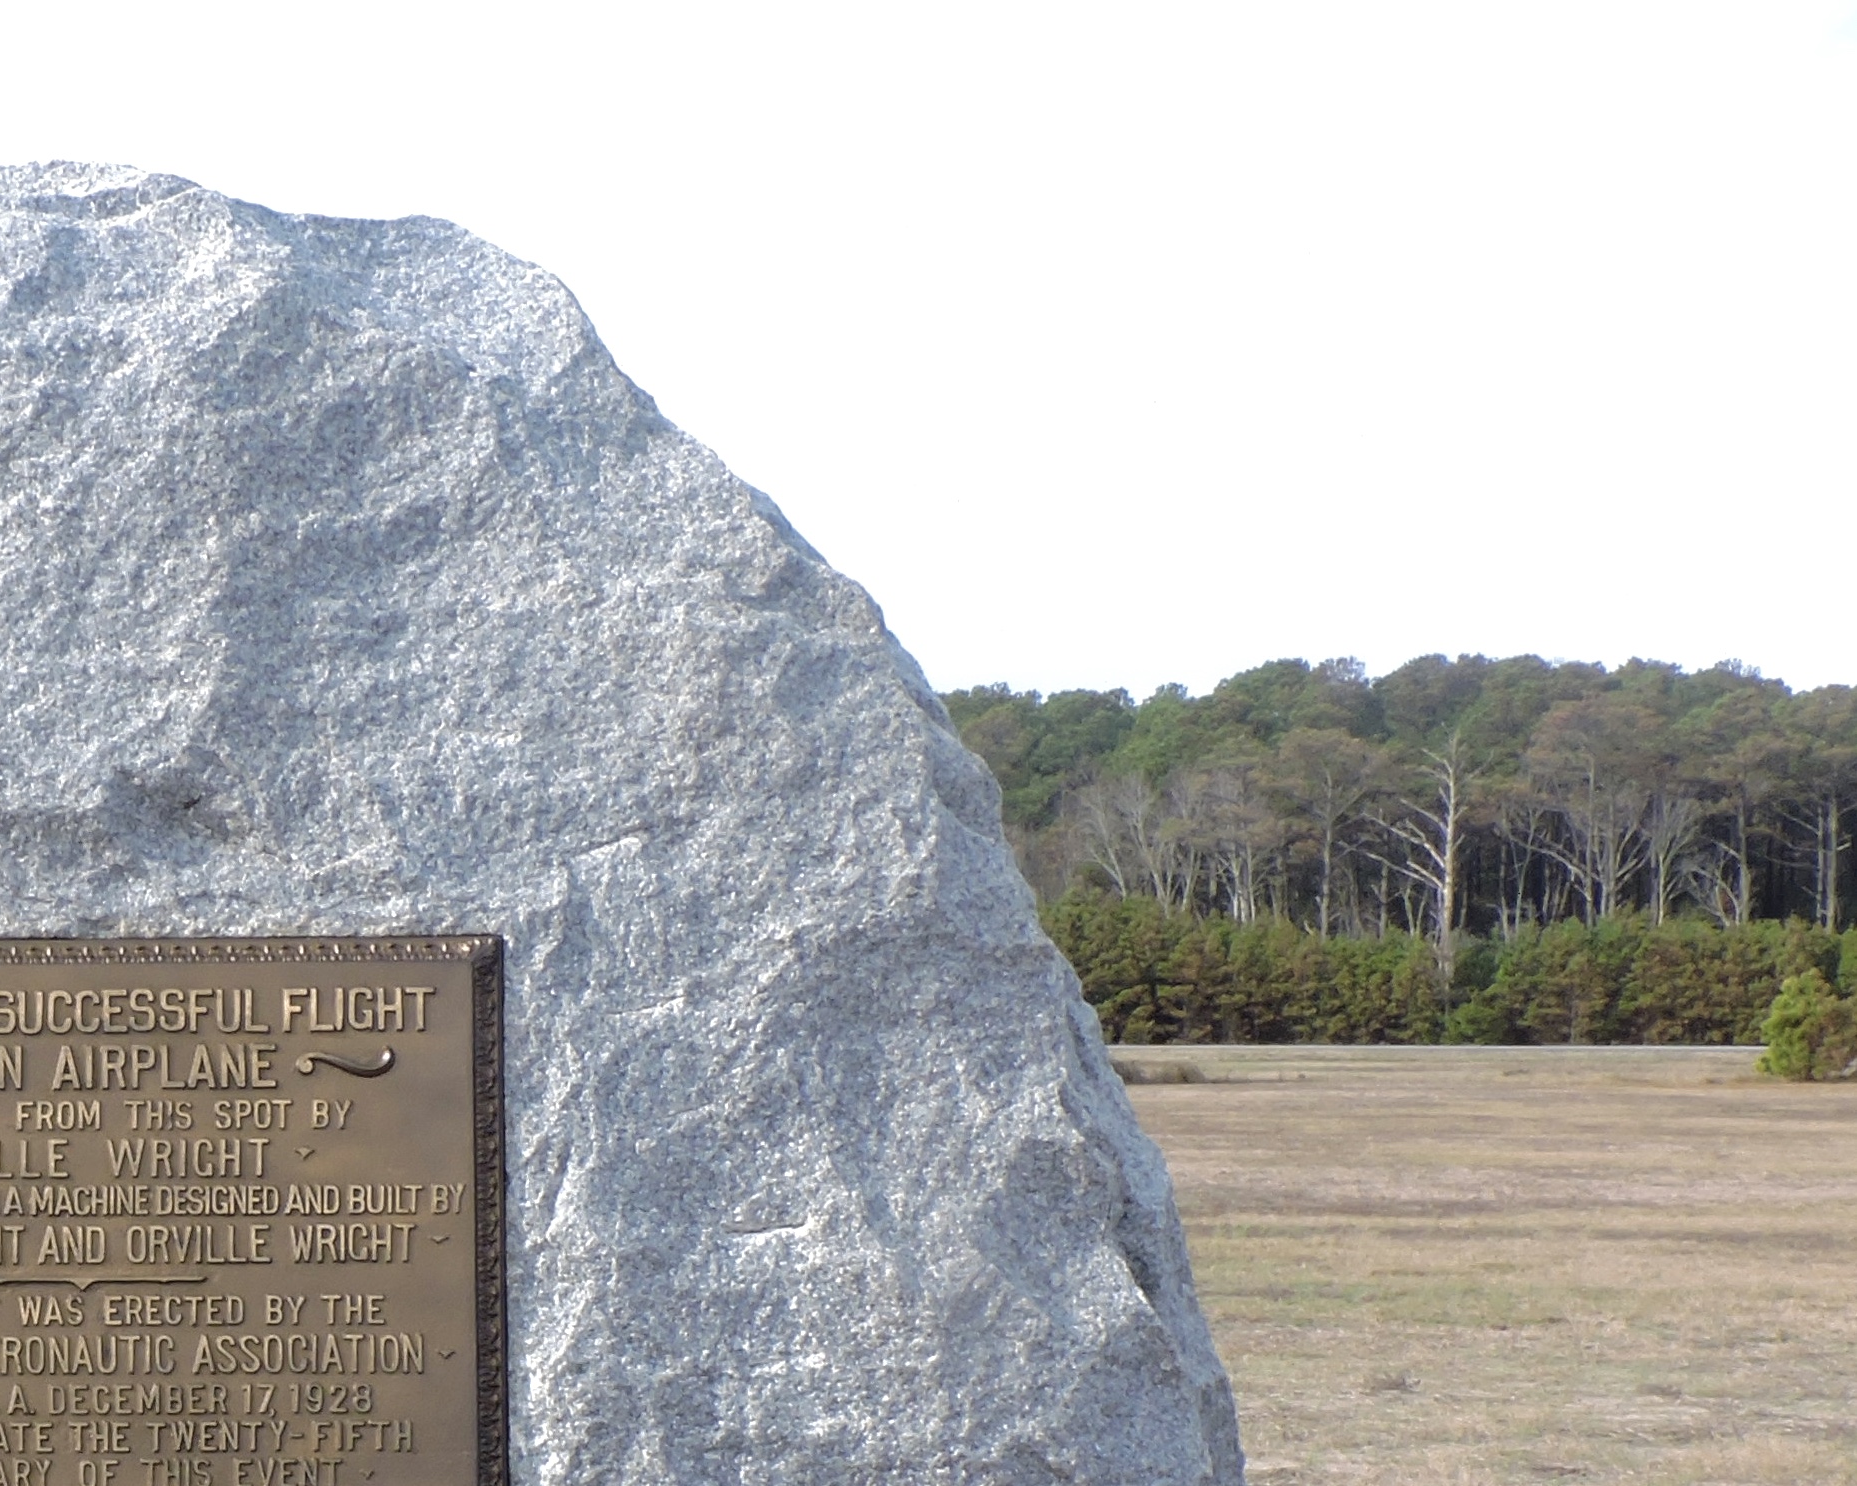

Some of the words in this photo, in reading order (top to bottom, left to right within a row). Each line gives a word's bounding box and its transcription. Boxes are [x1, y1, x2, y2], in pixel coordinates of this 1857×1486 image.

[281, 987, 436, 1033] FLIGHT
[51, 1043, 277, 1090] AIRPLANE
[16, 1100, 102, 1131] FROM
[124, 1100, 193, 1131] THIS
[215, 1099, 292, 1130] SPOT
[311, 1099, 353, 1130] BY
[106, 1137, 270, 1178] WRIGHT
[3, 1186, 25, 1217] A
[29, 1184, 149, 1218] MACHINE
[156, 1183, 279, 1216] DESIGNED
[284, 1183, 340, 1215] AND
[347, 1183, 424, 1214] BUILT
[430, 1182, 466, 1214] BY
[38, 1224, 106, 1265] AND
[126, 1224, 272, 1264] ORVILLE
[289, 1223, 417, 1263] WRIGHT
[18, 1295, 85, 1327] WAS
[104, 1295, 244, 1326] ERECTED
[265, 1295, 306, 1325] BY
[320, 1294, 386, 1325] THE
[192, 1332, 425, 1375] ASSOCIATION
[48, 1383, 229, 1416] DECEMBER
[241, 1384, 277, 1418] 17,
[289, 1383, 373, 1414] 1928
[68, 1421, 131, 1453] THE
[146, 1420, 414, 1452] TWENTY-FIFTH
